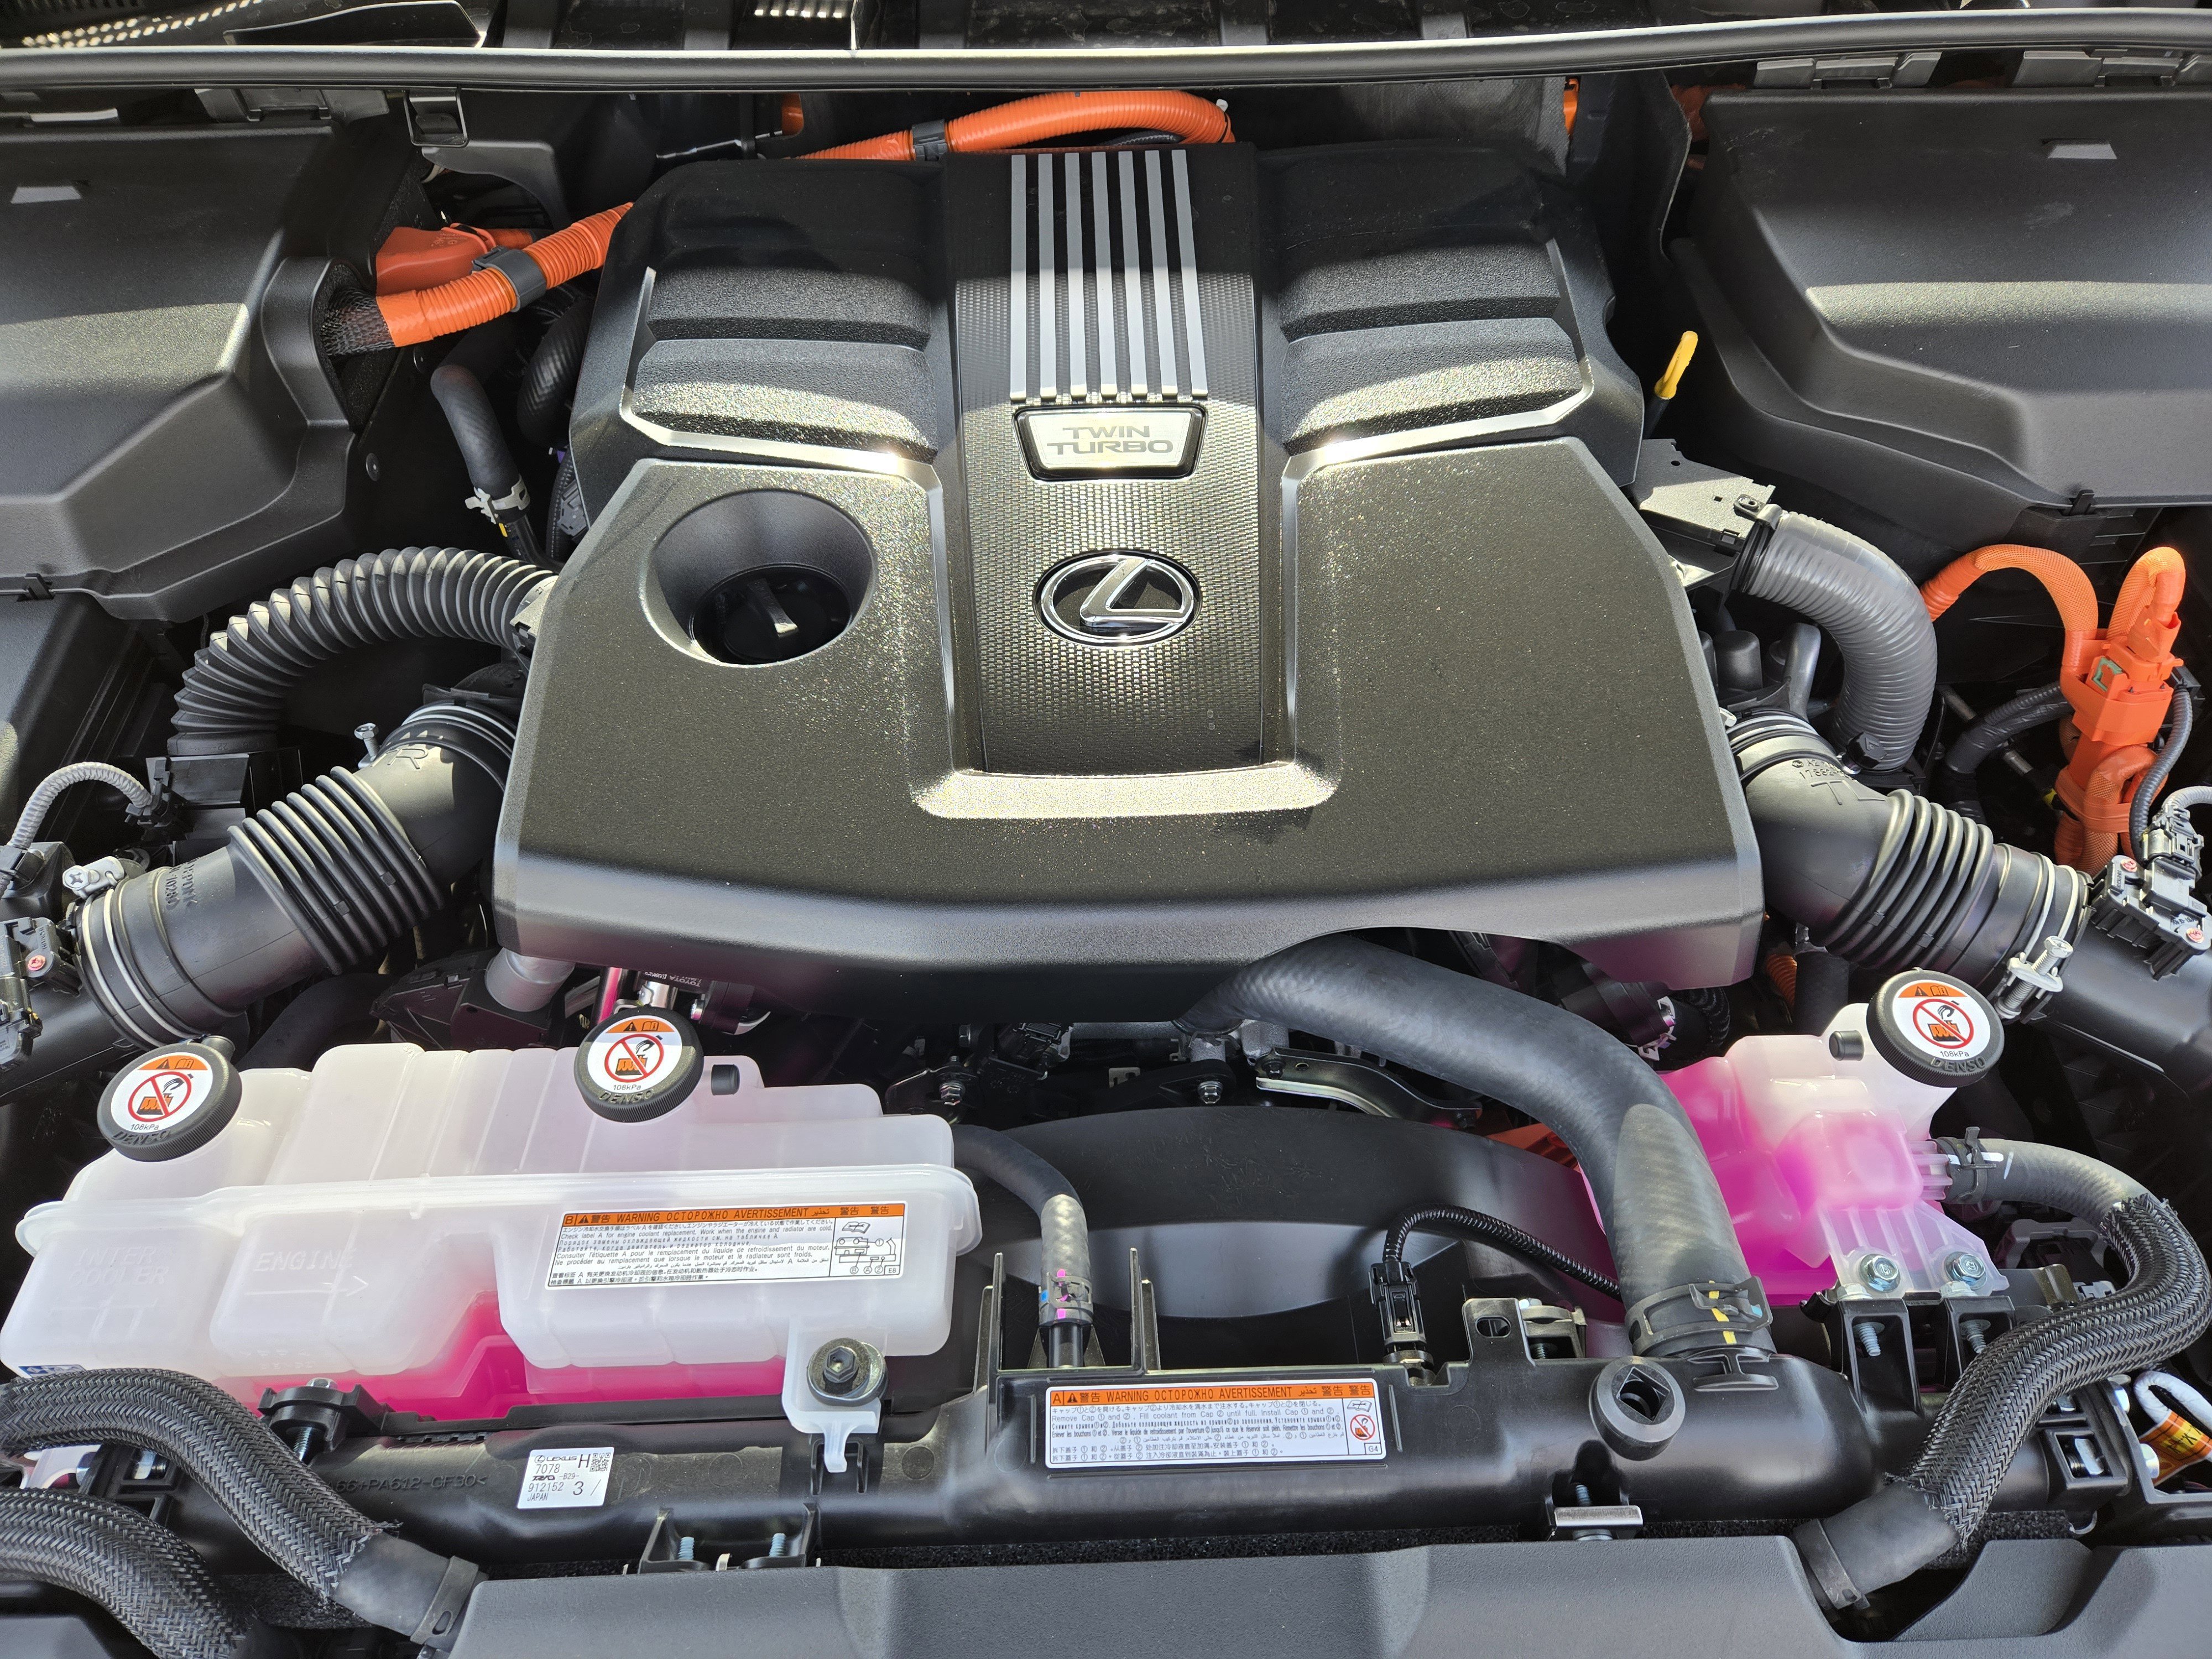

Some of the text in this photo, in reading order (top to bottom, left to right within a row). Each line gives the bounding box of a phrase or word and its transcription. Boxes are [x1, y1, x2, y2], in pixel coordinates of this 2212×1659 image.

[1062, 425, 1150, 439] TWIN
[1047, 440, 1173, 455] TURBO
[669, 975, 701, 987] TOYOTA
[1931, 1057, 1986, 1072] DENSO
[598, 1088, 654, 1104] DENSO
[113, 1130, 171, 1145] DENSO
[563, 1215, 573, 1224] B
[617, 1212, 660, 1223] WARNING
[666, 1211, 728, 1221] ОСТОРОЖНО
[733, 1208, 808, 1219] AVERTISSEMENT
[77, 1246, 157, 1265] INTER
[254, 1248, 354, 1271] ENGINE
[69, 1265, 169, 1285] COOLER
[1052, 1392, 1061, 1404] A
[1106, 1390, 1149, 1402] WARNING
[1154, 1389, 1213, 1401] ОСТОРОЖНО
[1219, 1386, 1292, 1399] AVERTISSEMENT
[535, 1464, 560, 1474] 7078
[578, 1454, 591, 1469] H
[528, 1481, 584, 1495] 912152 3
[527, 1493, 549, 1501] JAPAN
